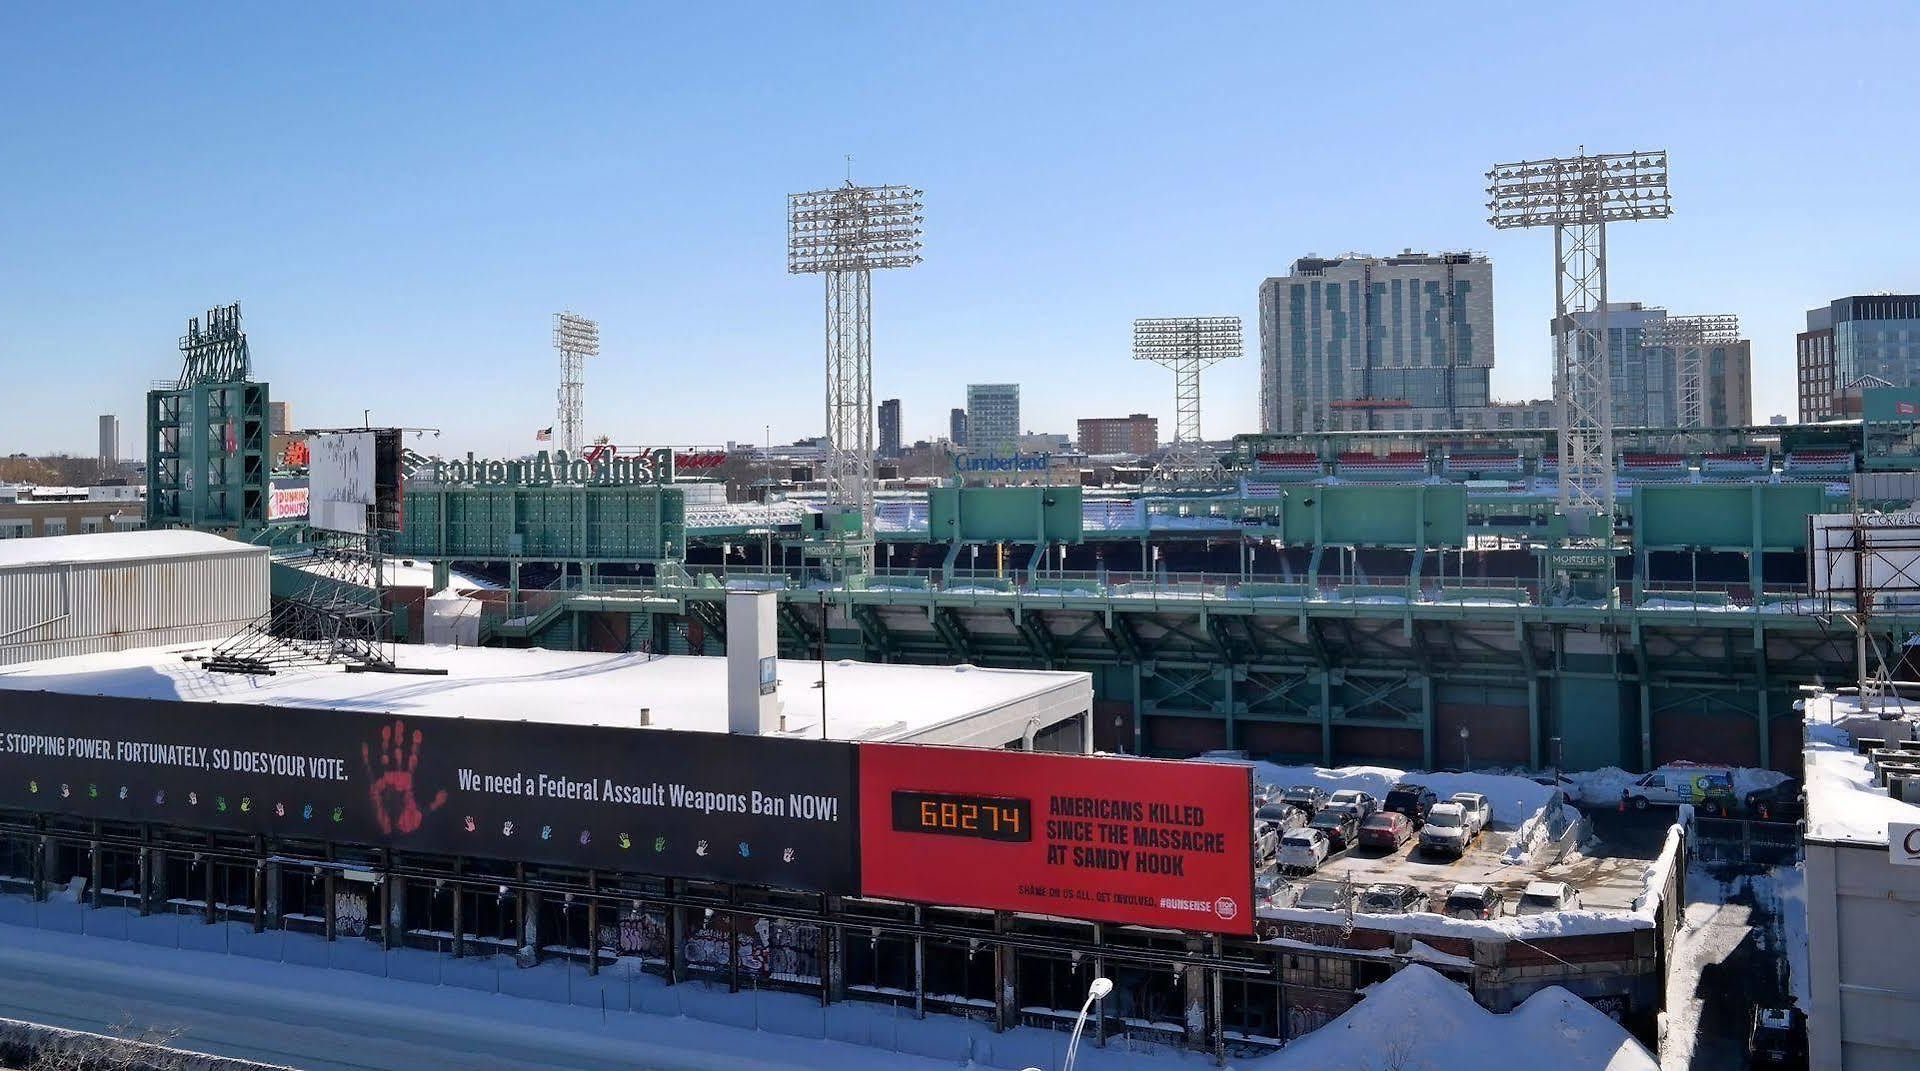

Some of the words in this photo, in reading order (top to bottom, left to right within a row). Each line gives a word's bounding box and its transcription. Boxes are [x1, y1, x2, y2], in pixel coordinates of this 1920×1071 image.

[956, 452, 1047, 471] Cumberland
[279, 503, 307, 516] DONUTS
[1552, 554, 1605, 564] MONSTER
[6, 733, 65, 756] STOPPING
[68, 738, 114, 760] POWER.
[117, 741, 210, 771] FORTUNATELY,
[213, 748, 230, 770] SO
[309, 757, 349, 780] VOTE.
[458, 768, 481, 791] We
[485, 773, 521, 795] need
[526, 777, 535, 796] a
[539, 774, 598, 801] Federal
[602, 779, 665, 806] Assault
[669, 783, 747, 814] Weapons
[751, 790, 785, 817] Ban
[789, 793, 838, 822] NOW!
[1050, 795, 1144, 821] AMERICANS
[1149, 803, 1205, 826] KILLED
[921, 801, 1020, 833] 68274
[1046, 820, 1093, 841] SINCE
[1098, 823, 1128, 845] THE
[1133, 827, 1225, 854] MASSACRE
[1047, 844, 1068, 865] AT
[1073, 846, 1130, 872] SANDY
[1136, 852, 1184, 877] HOOK
[1019, 885, 1047, 897] SHAME
[1049, 888, 1060, 898] ON
[1063, 889, 1074, 899] US
[1096, 892, 1110, 903] GET
[1114, 894, 1157, 907] INVOLVED.
[1160, 897, 1212, 912] #GUNSENSE
